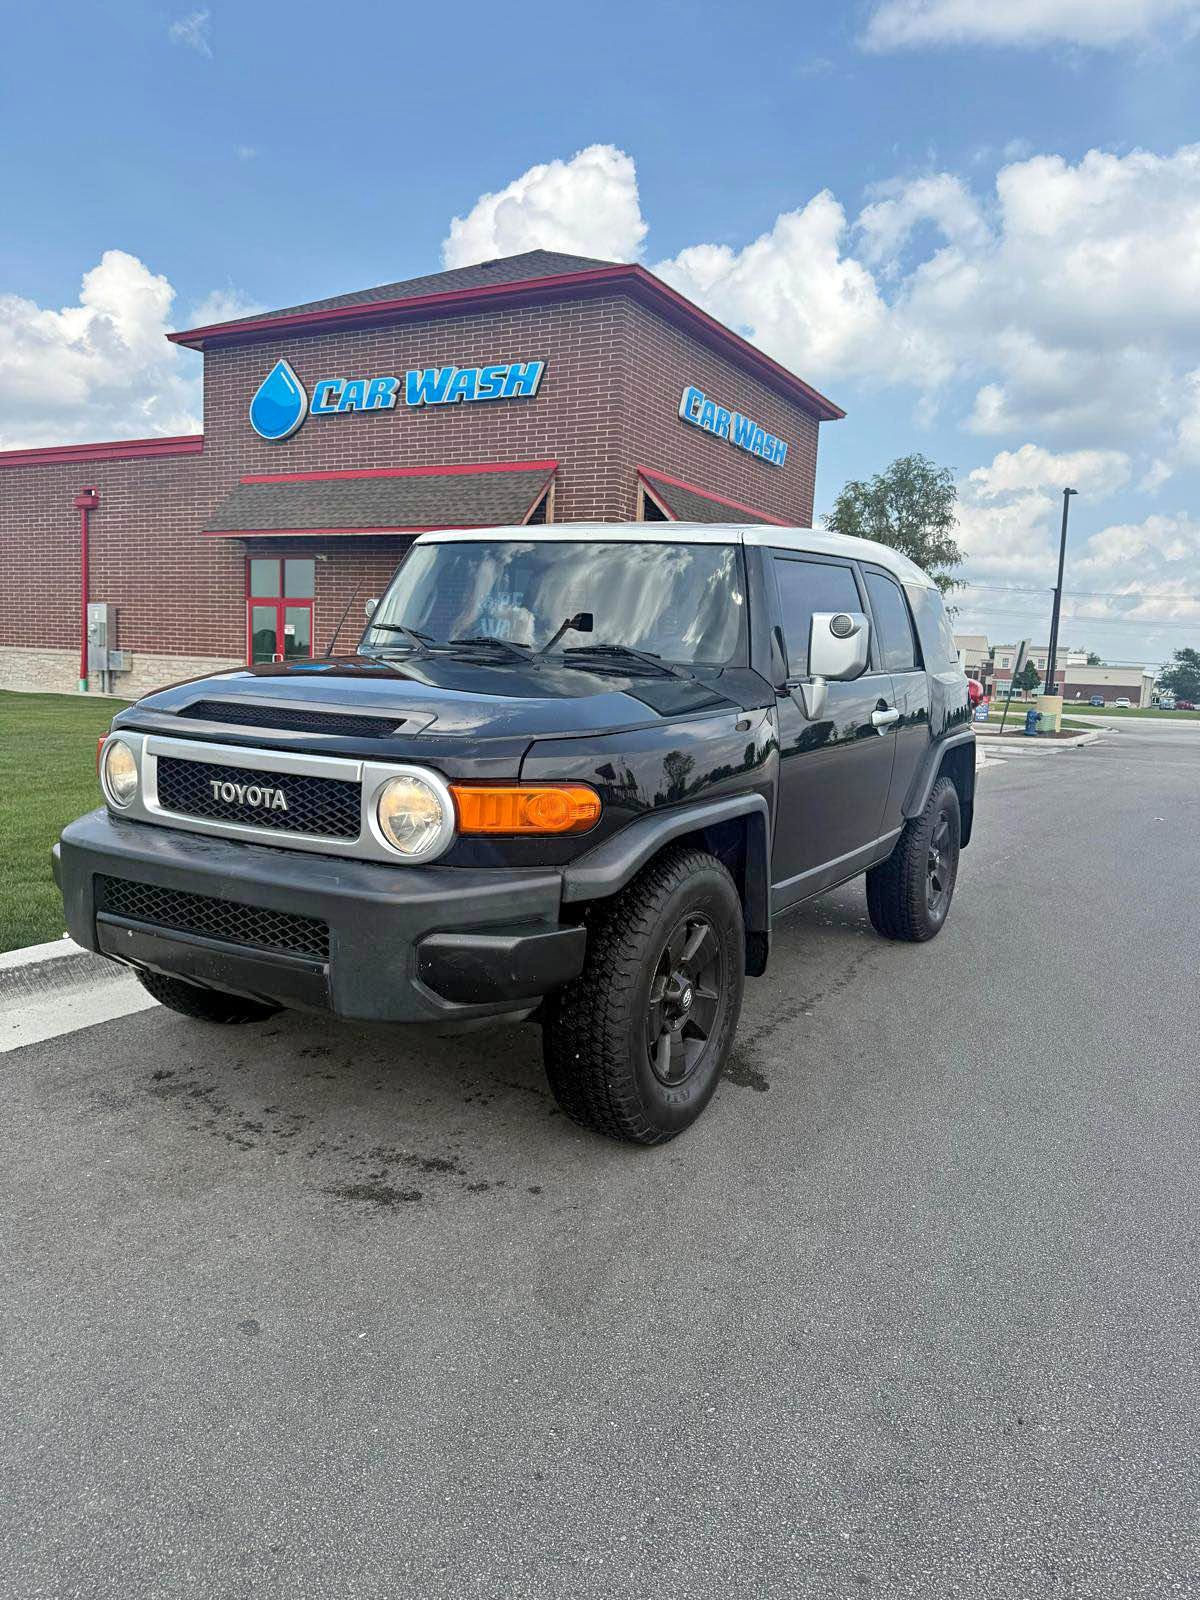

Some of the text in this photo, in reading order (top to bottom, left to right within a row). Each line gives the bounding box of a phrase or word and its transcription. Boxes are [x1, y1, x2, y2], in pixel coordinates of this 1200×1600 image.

[310, 361, 544, 415] CAR WASH
[679, 386, 788, 467] CAR WASH
[210, 780, 288, 811] TOYOTA
